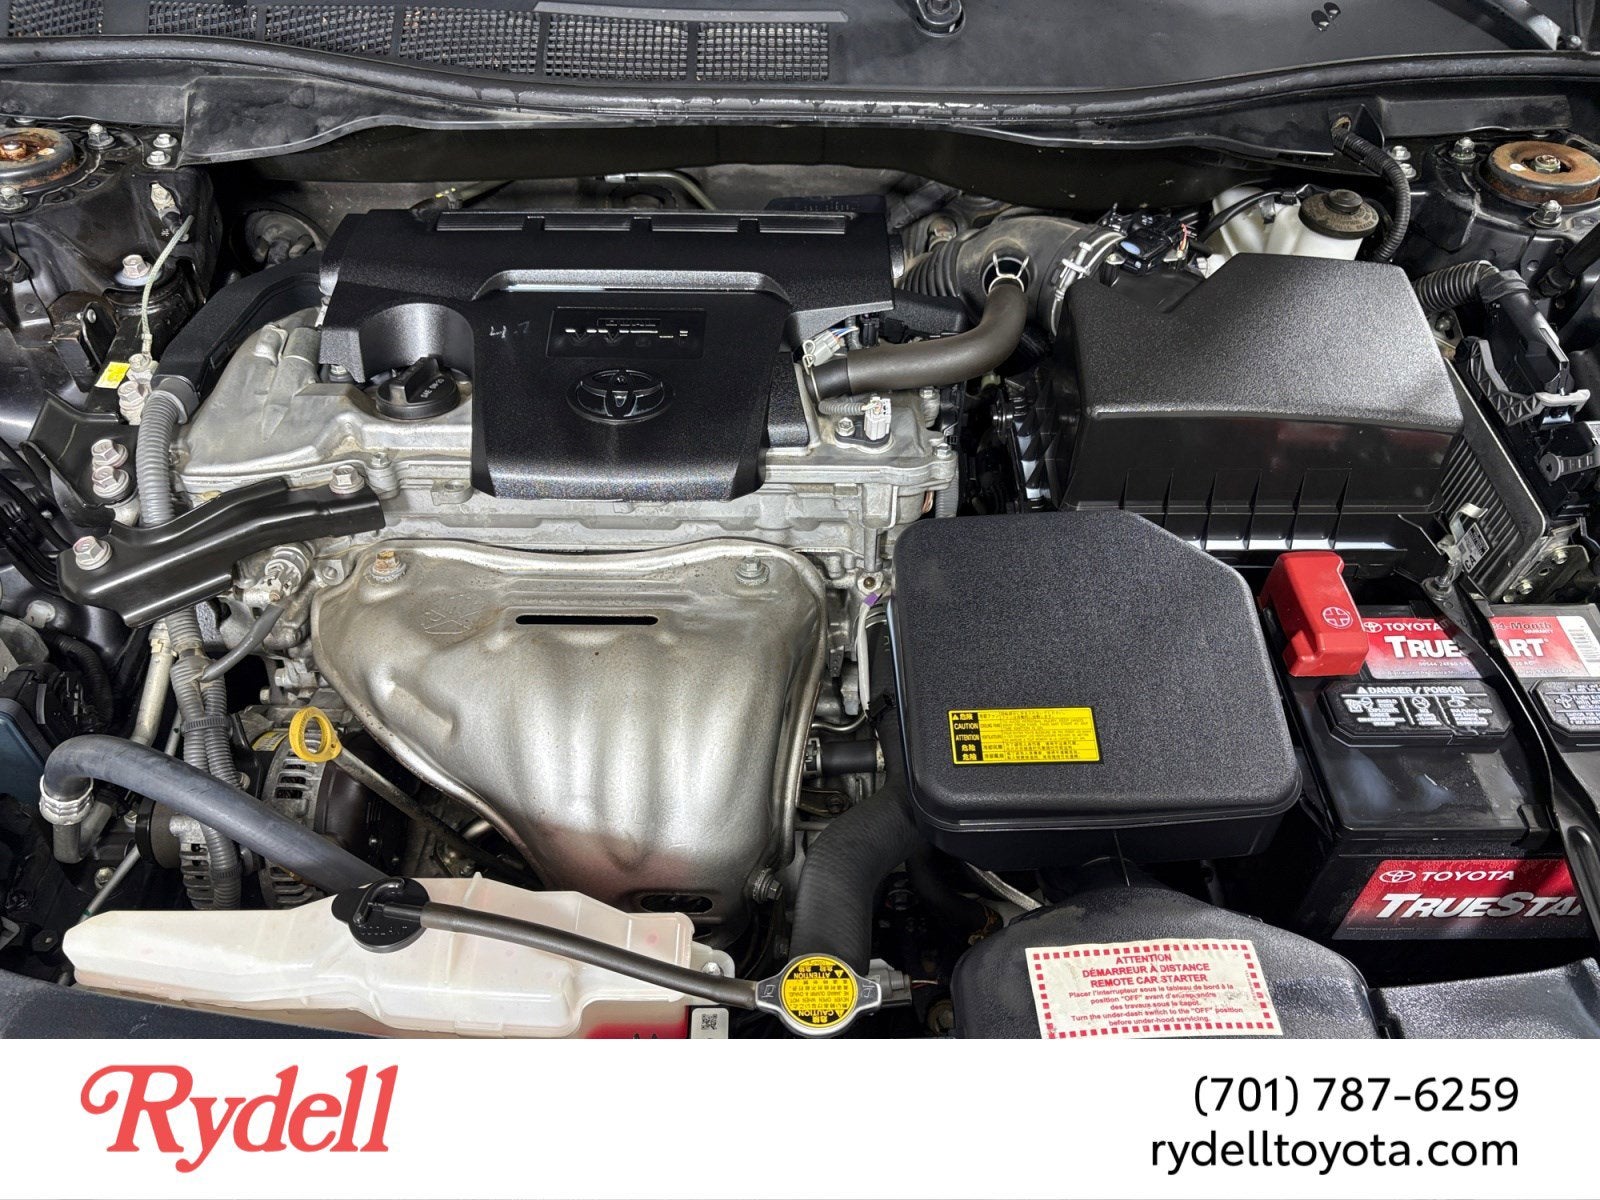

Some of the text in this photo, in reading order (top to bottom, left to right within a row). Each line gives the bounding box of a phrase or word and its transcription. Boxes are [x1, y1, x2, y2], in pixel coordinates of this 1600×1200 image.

[1383, 622, 1444, 632] TOYOTA
[1368, 686, 1414, 694] DANGER
[1424, 686, 1465, 694] POISON
[1421, 870, 1514, 882] TOYOTA
[1376, 892, 1582, 918] TRUESTA
[1116, 954, 1172, 964] ATTENTION
[1082, 967, 1149, 978] DÉMARREUR
[1160, 963, 1210, 972] DISTANCE
[1091, 974, 1208, 988] REMOTE CAR STARTER
[1091, 997, 1119, 1005] position
[1102, 1011, 1143, 1019] under-dash
